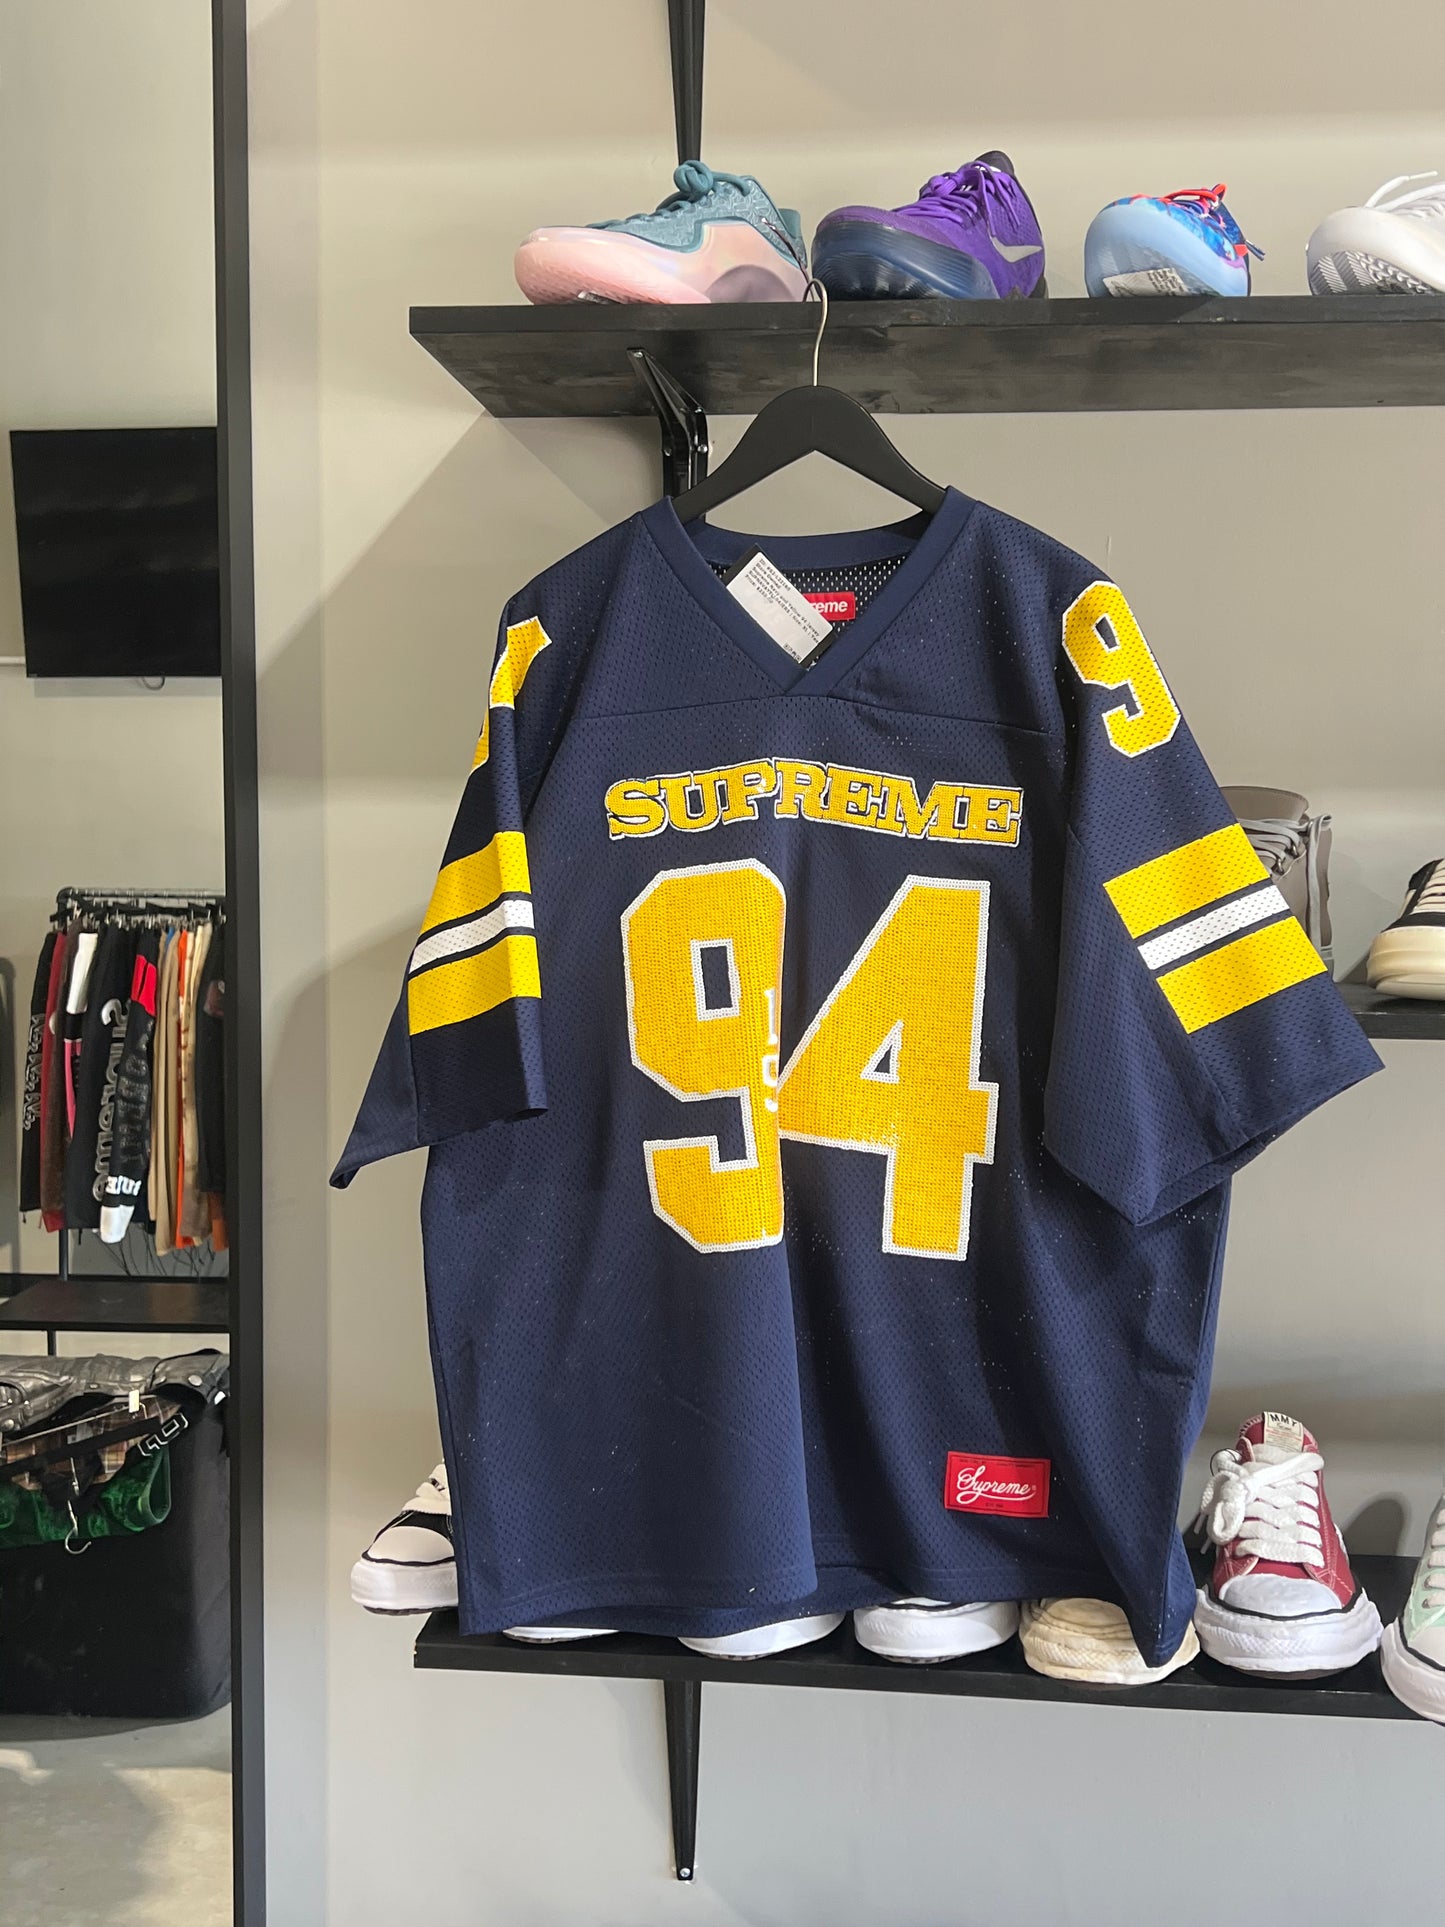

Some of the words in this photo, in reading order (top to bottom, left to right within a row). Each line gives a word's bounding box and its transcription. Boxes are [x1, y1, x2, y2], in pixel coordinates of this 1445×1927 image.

[751, 566, 770, 585] Supreme
[1062, 580, 1182, 758] 9
[604, 757, 1023, 847] SUPREME
[621, 858, 999, 1261] 94
[1270, 1413, 1297, 1426] MMY
[956, 1465, 1036, 1504] Supreme
